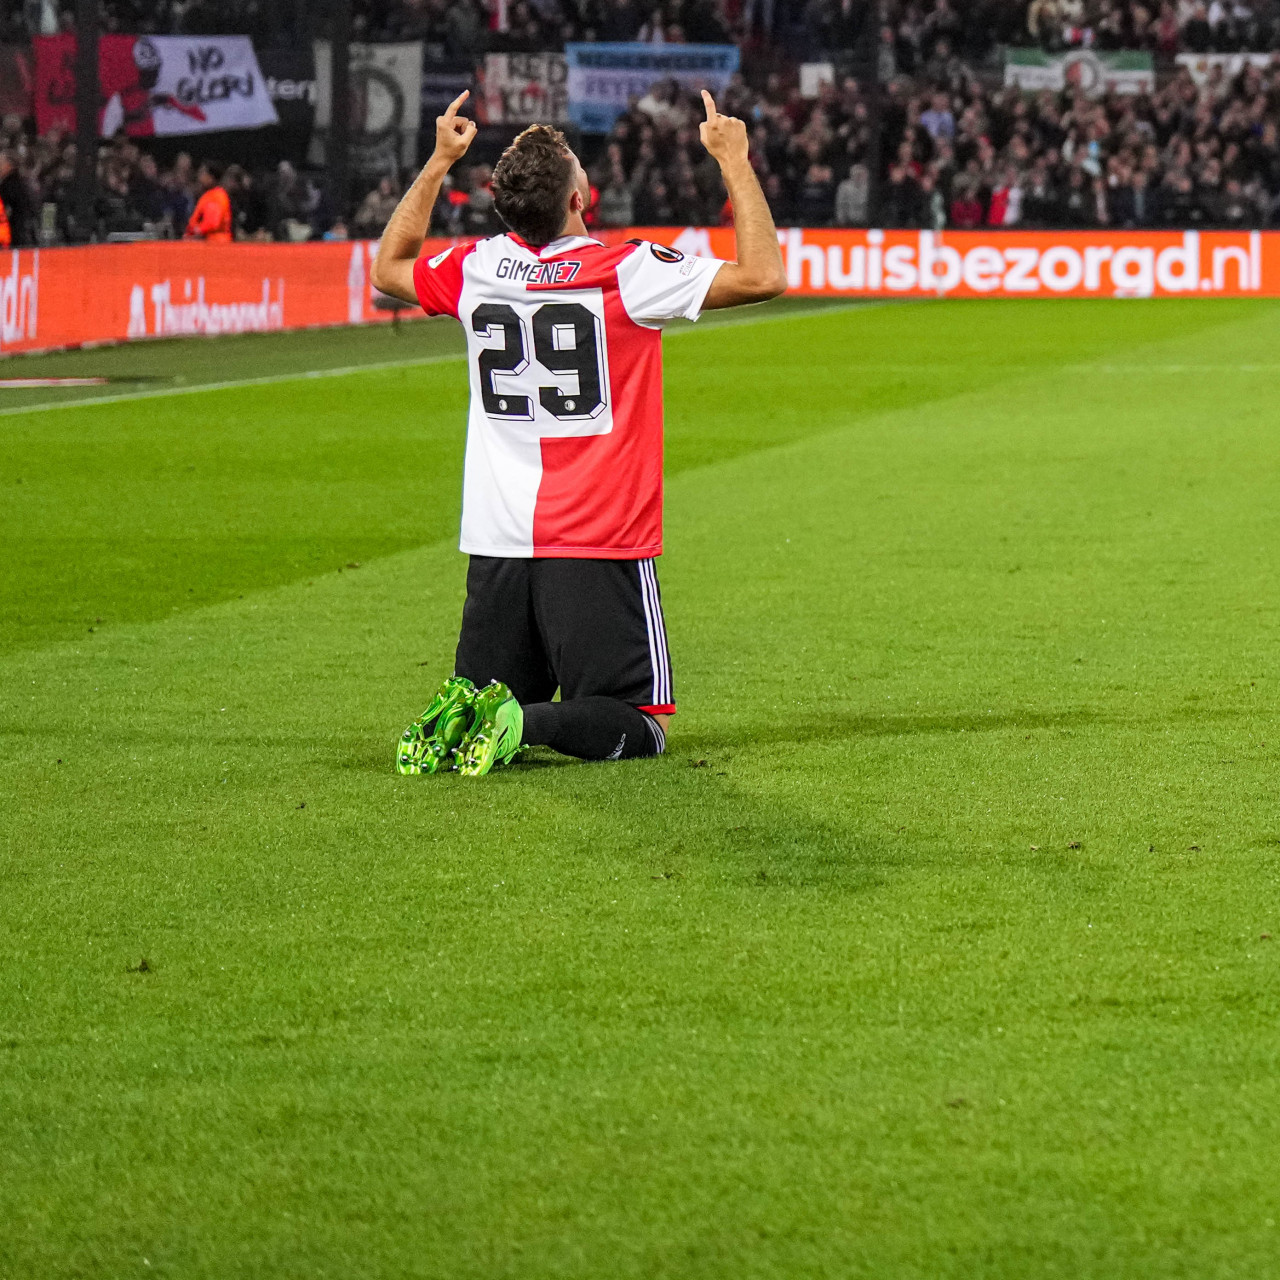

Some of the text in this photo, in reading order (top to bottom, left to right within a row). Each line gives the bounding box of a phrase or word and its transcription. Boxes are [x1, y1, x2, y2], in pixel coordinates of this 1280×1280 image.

[496, 257, 582, 284] GIMENEZ
[776, 229, 1262, 297] huisbezorgd.nl
[471, 302, 607, 421] 29
